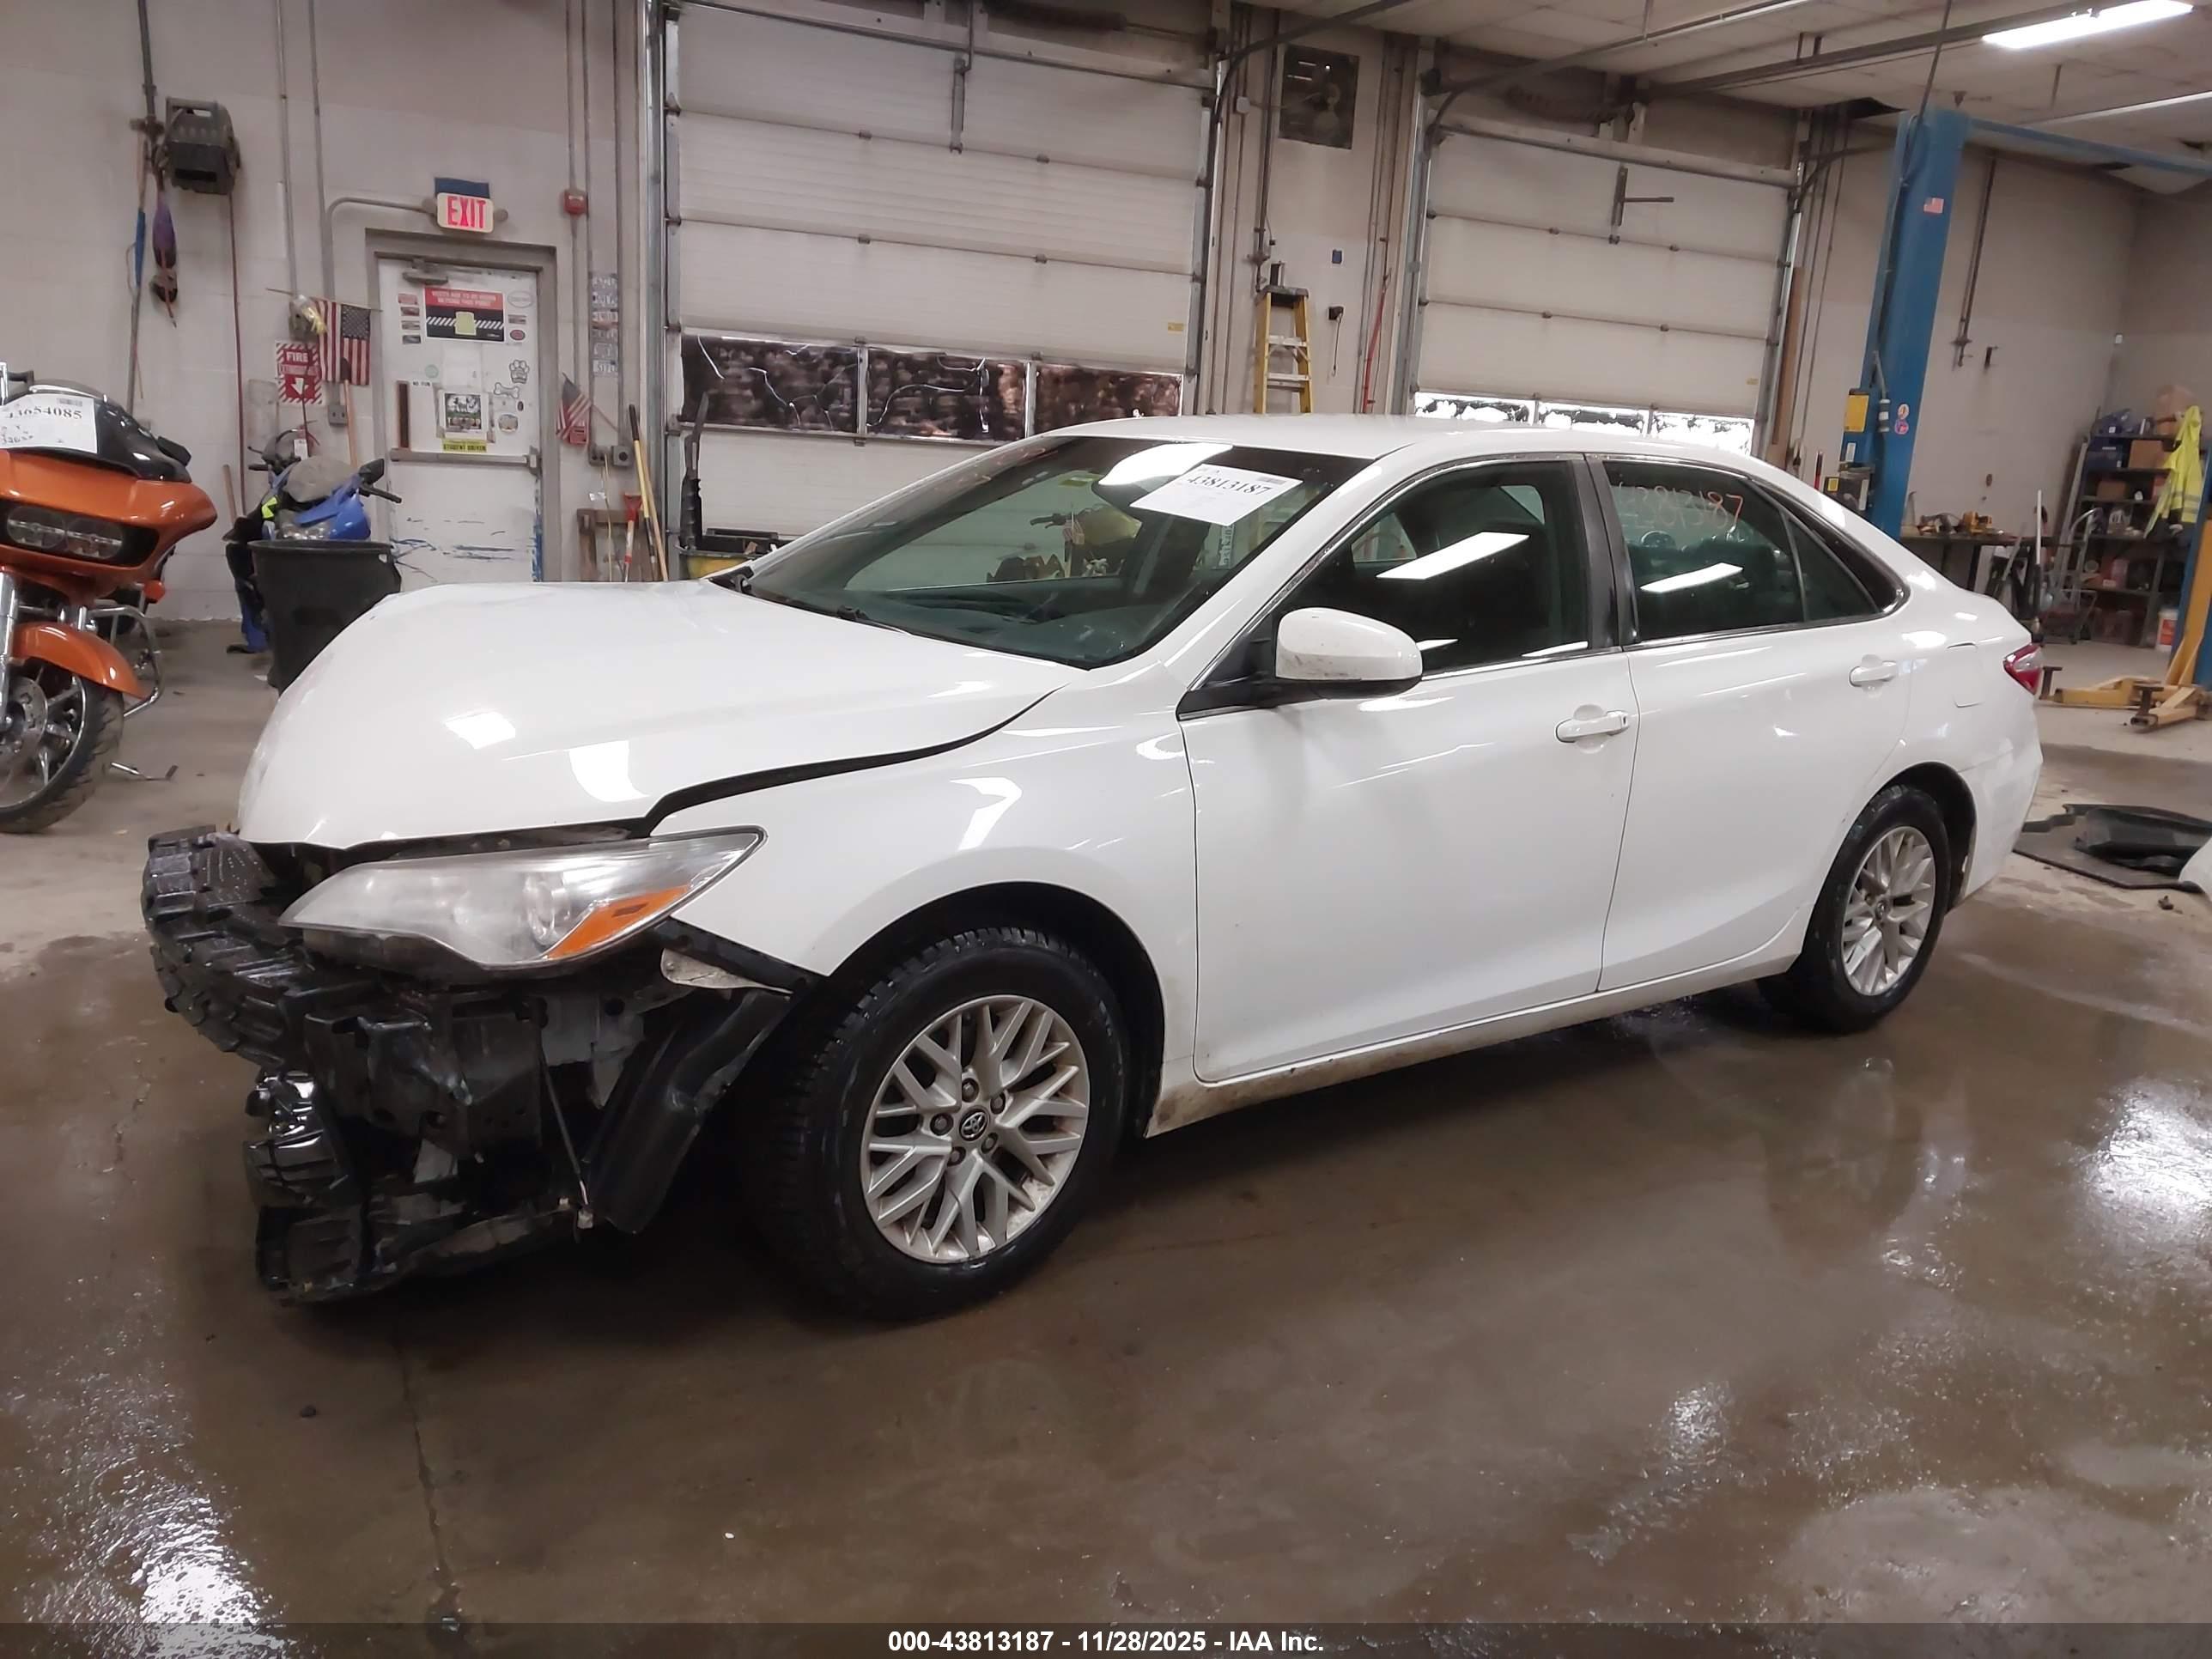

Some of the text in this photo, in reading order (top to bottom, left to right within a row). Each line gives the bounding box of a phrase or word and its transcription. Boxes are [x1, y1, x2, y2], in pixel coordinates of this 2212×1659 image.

[447, 196, 486, 228] EXIT
[286, 351, 308, 362] FIRE
[1187, 475, 1273, 496] 43813187
